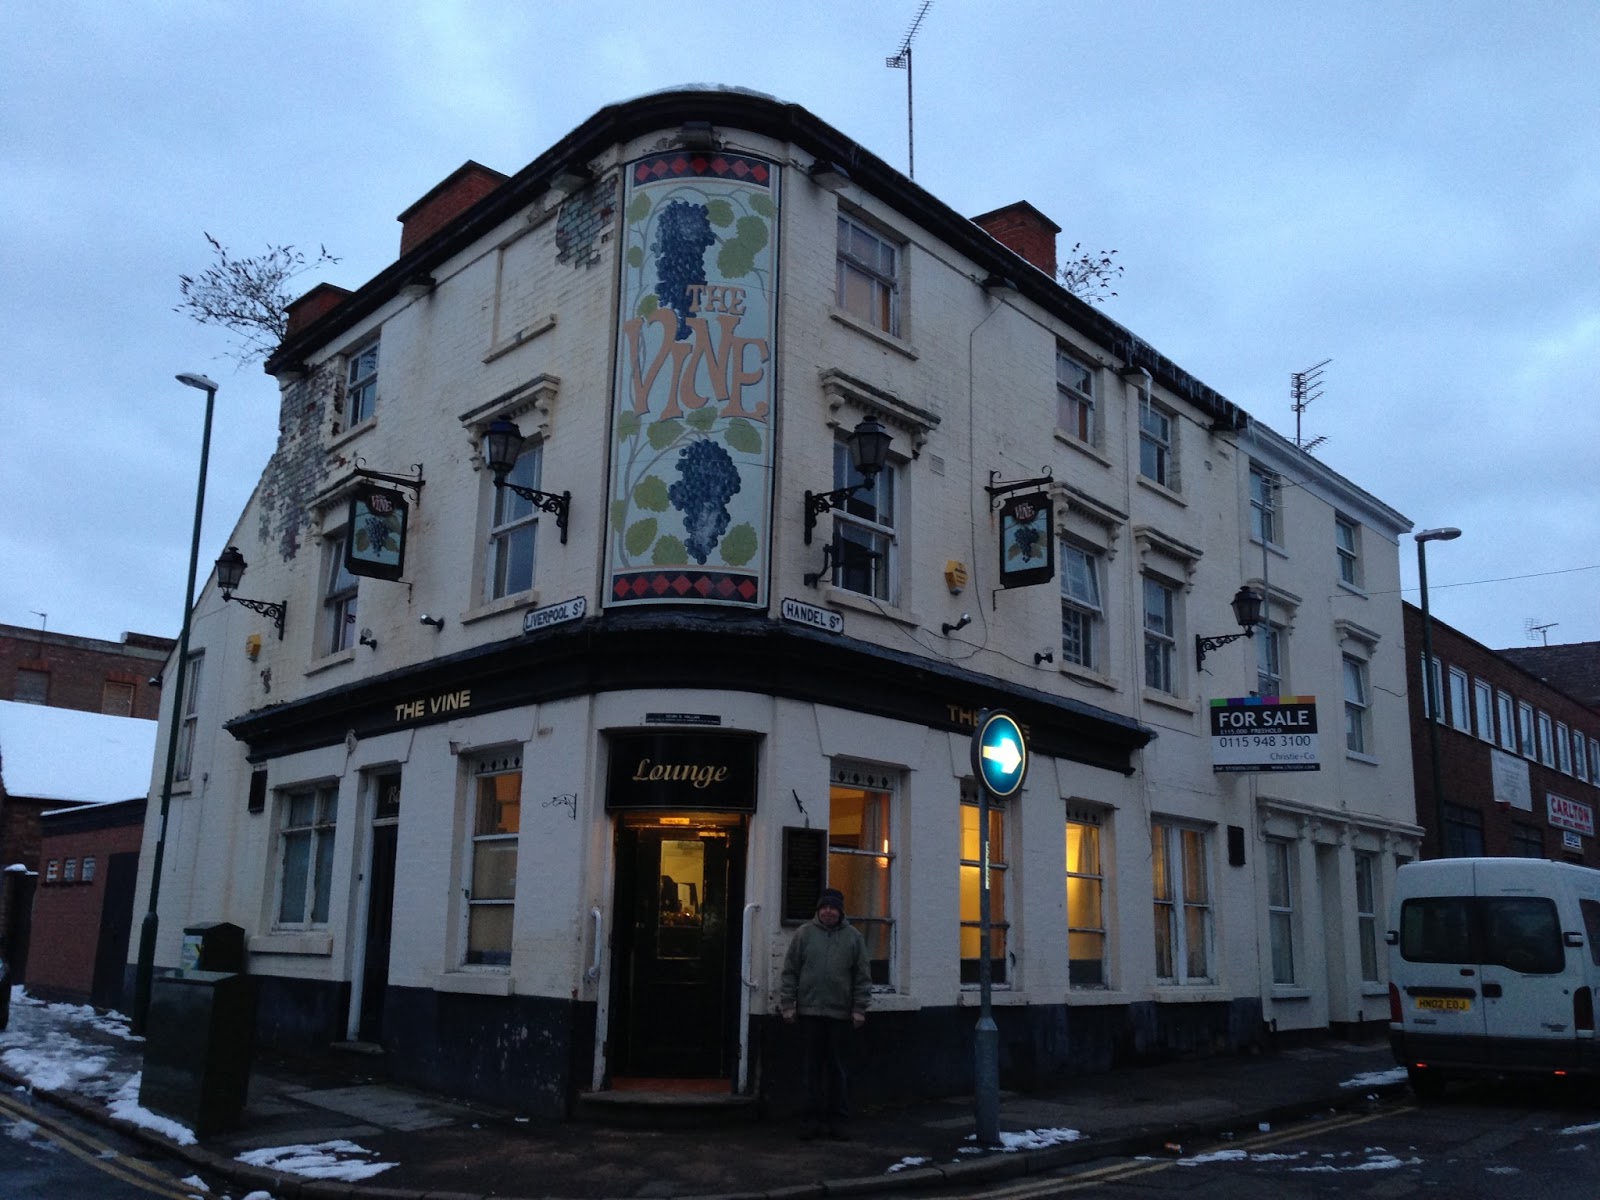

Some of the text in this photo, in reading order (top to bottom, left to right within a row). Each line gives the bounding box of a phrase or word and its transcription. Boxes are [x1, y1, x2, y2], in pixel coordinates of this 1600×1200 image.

[686, 284, 747, 316] THE
[623, 308, 770, 424] VINE
[525, 605, 569, 628] LIVERPOOL
[787, 602, 827, 626] HANDEL
[396, 690, 471, 721] THE VINE
[1219, 710, 1309, 727] FOR SALE
[1220, 735, 1311, 748] 0115 948 3100
[632, 758, 728, 789] Lounge
[1551, 796, 1590, 824] CARLTON
